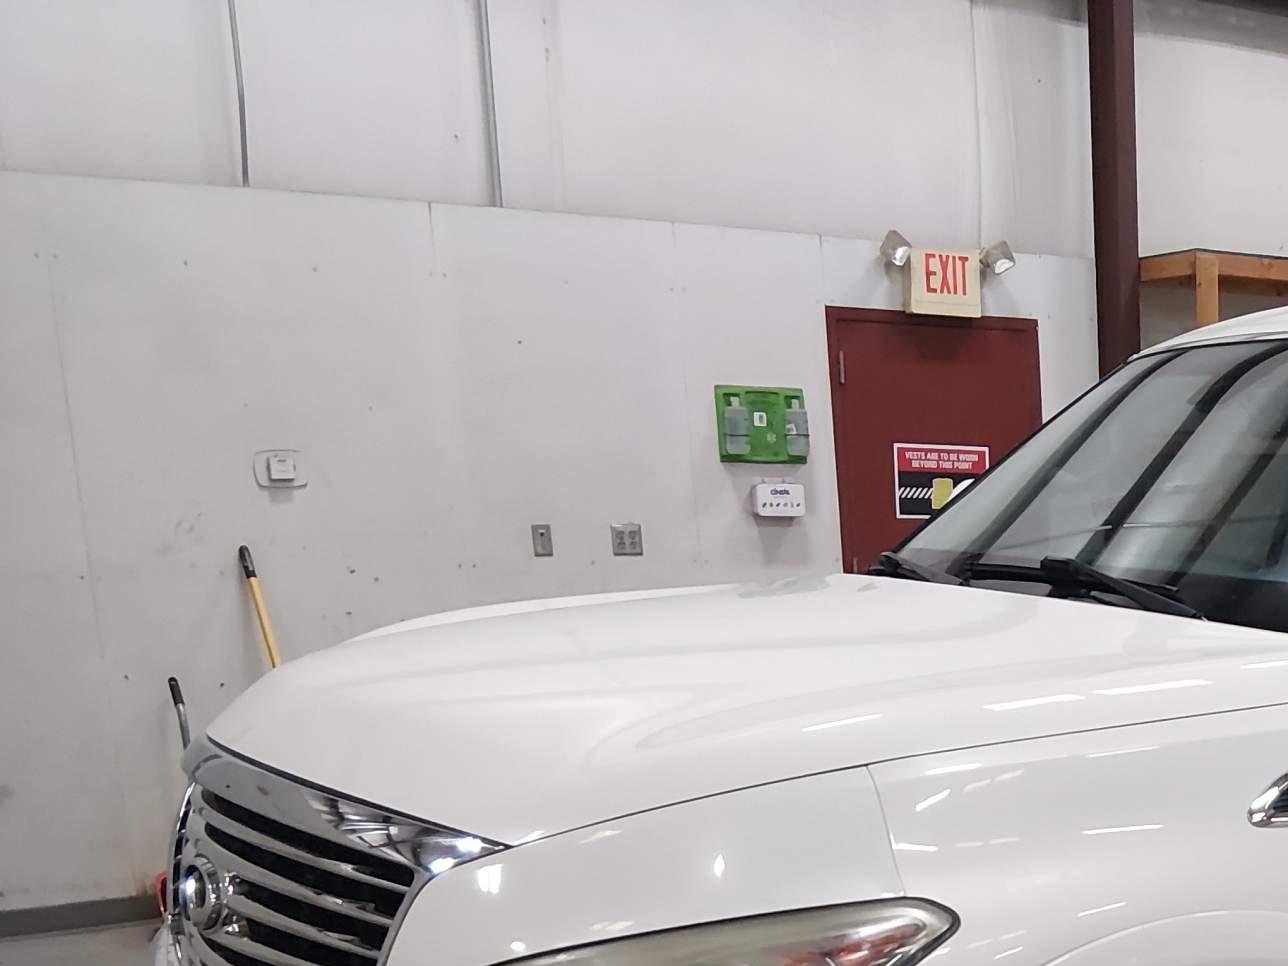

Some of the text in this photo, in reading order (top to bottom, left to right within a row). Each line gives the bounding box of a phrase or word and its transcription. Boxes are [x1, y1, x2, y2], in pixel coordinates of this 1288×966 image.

[925, 253, 969, 296] EXIT
[905, 451, 925, 460] VESTS
[926, 452, 939, 460] ARE
[940, 452, 948, 461] TO
[949, 453, 958, 461] BE
[911, 460, 938, 468] BEYOND
[954, 461, 972, 469] POINT
